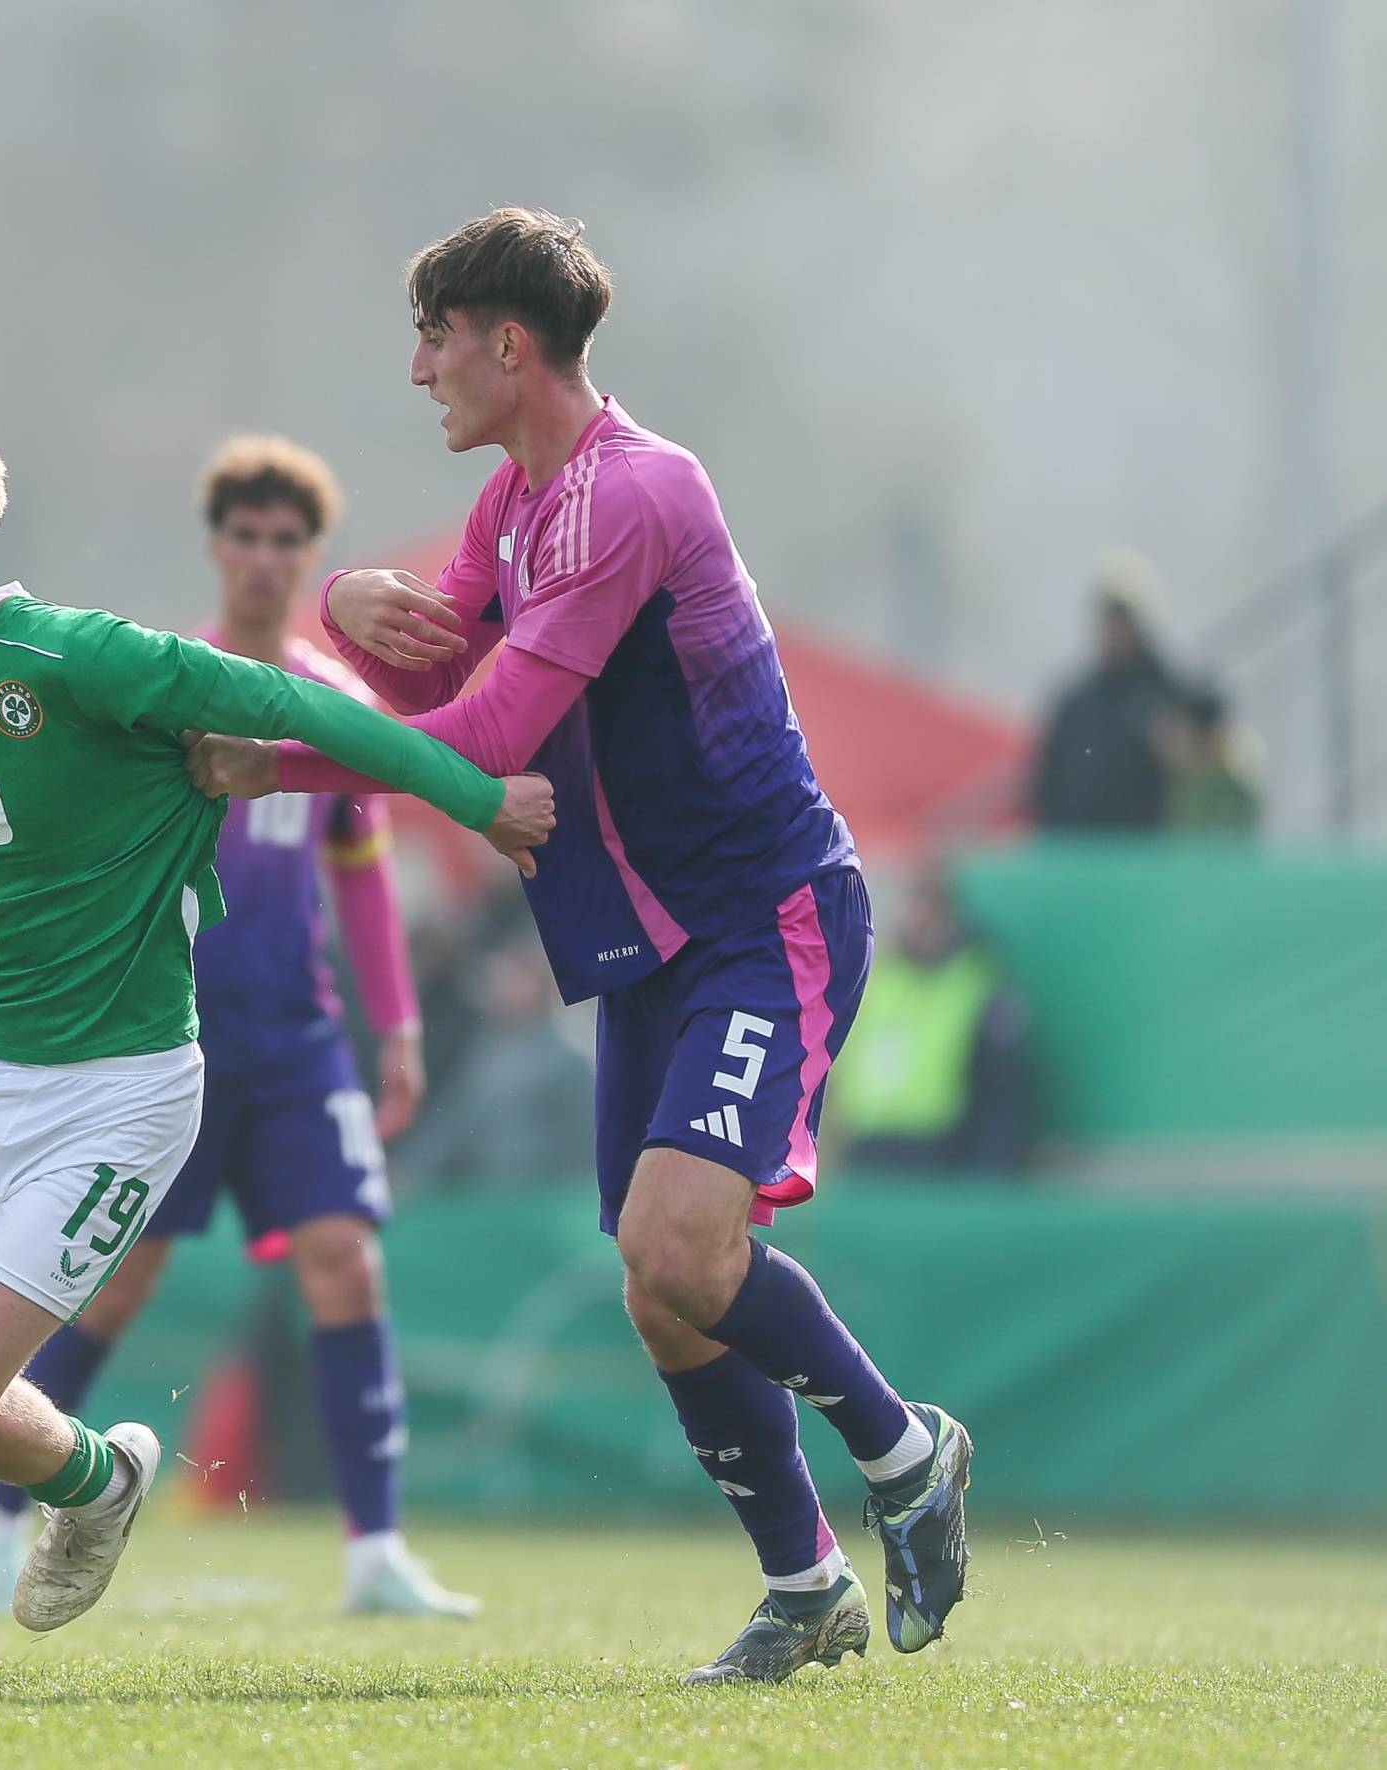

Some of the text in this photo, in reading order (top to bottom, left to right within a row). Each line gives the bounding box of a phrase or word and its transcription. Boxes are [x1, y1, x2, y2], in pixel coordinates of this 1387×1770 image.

[597, 945, 639, 962] HEAT.RDY
[713, 1010, 774, 1100] 5
[61, 1163, 150, 1256] 19
[687, 1440, 743, 1462] FB
